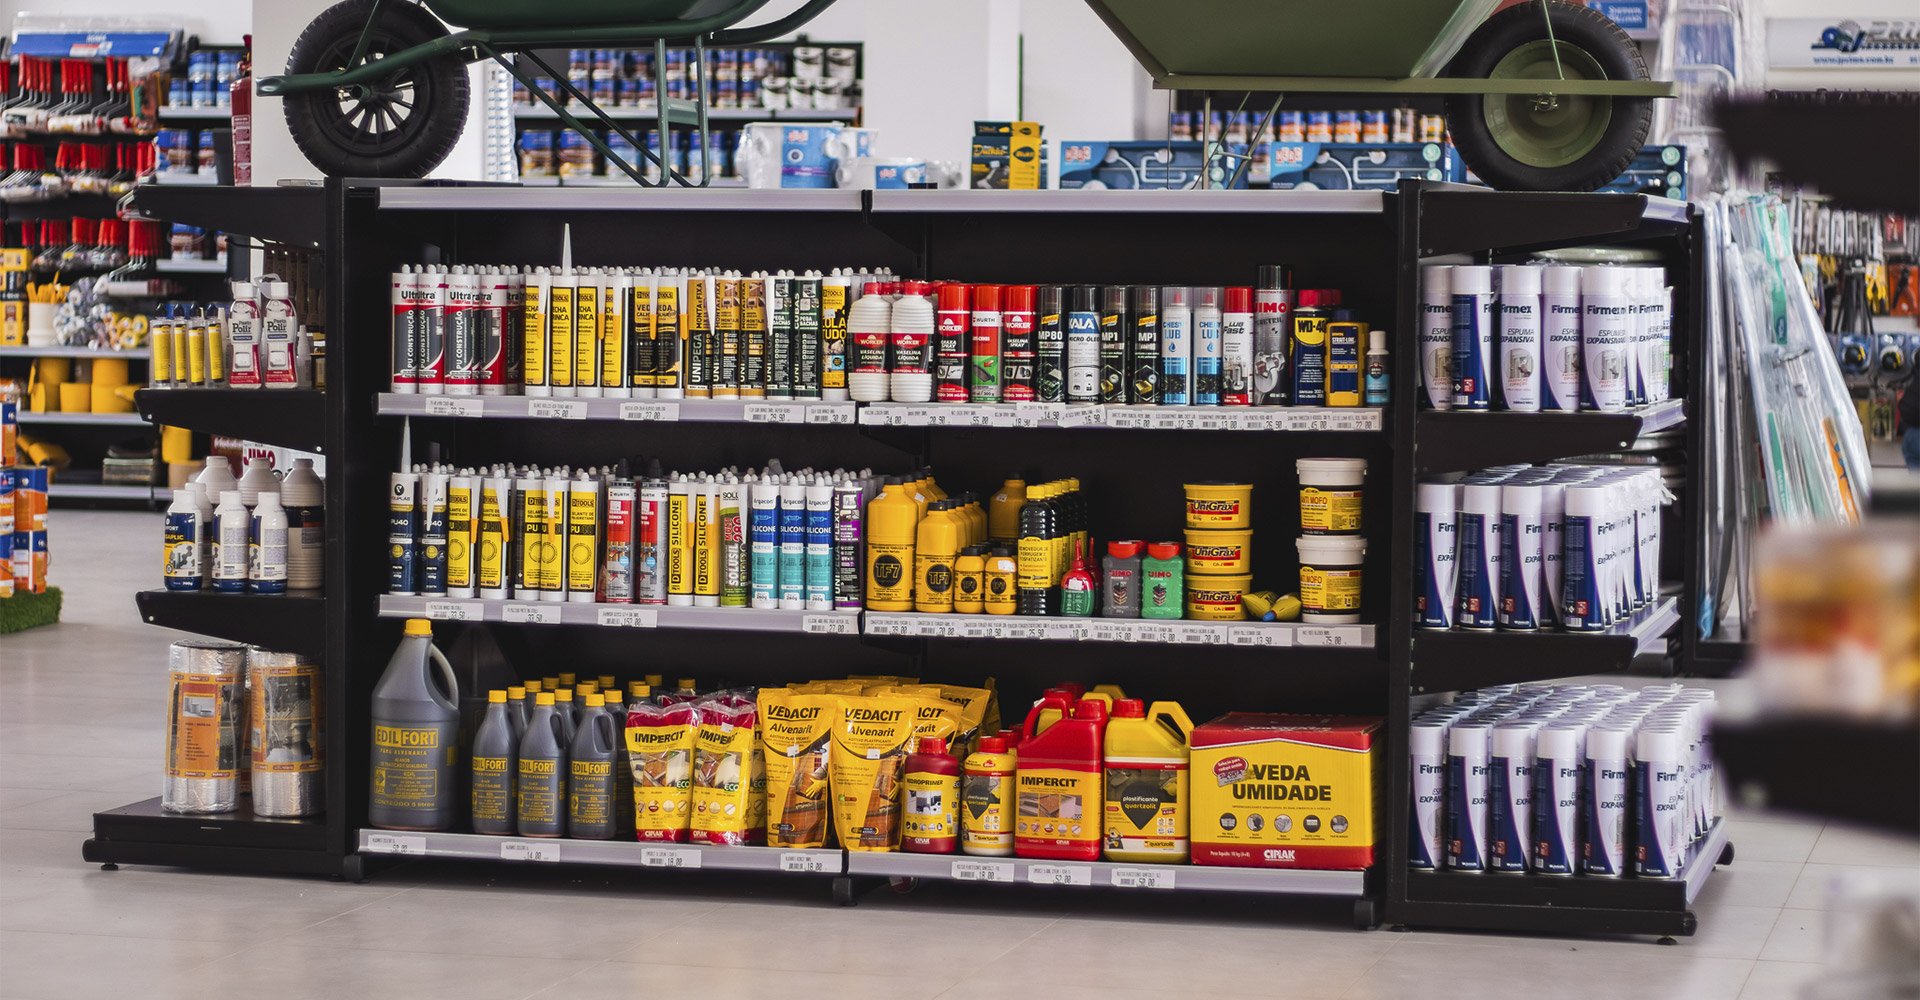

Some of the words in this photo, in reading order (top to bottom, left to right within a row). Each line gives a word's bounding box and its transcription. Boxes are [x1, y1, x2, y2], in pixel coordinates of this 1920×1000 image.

[1551, 304, 1580, 314] Firme
[232, 322, 252, 333] Polir
[267, 320, 287, 331] Polir
[1038, 331, 1063, 341] MP80
[1101, 332, 1118, 342] MP1
[1138, 332, 1157, 342] MP1
[1193, 500, 1234, 511] UniGrax
[671, 500, 679, 546] SILICONE
[699, 500, 707, 546] SILICONE
[1194, 547, 1235, 557] UniGrax
[671, 548, 681, 584] DTOOLS
[698, 549, 708, 584] DTOOLS
[728, 544, 740, 587] SOLUSIL
[875, 564, 900, 578] TF7
[928, 571, 950, 585] TF7
[1195, 591, 1236, 601] UniGrax
[767, 705, 820, 719] VEDACIT
[845, 708, 902, 721] VEDACIT
[769, 723, 812, 735] Alvenarit
[849, 726, 895, 737] Alvenarit
[376, 729, 399, 744] EDIL
[402, 731, 436, 745] FORT
[634, 730, 685, 744] IMPERCIT
[485, 760, 506, 770] FORT
[533, 762, 555, 772] FORT
[573, 763, 588, 774] EDIL
[589, 764, 610, 773] FORT
[1252, 764, 1311, 781] VEDA
[676, 780, 690, 789] ECO
[1021, 776, 1078, 787] IMPERCIT
[723, 783, 740, 792] ECO
[1232, 783, 1332, 801] UMIDADE
[1263, 849, 1296, 859] CIPLAK
